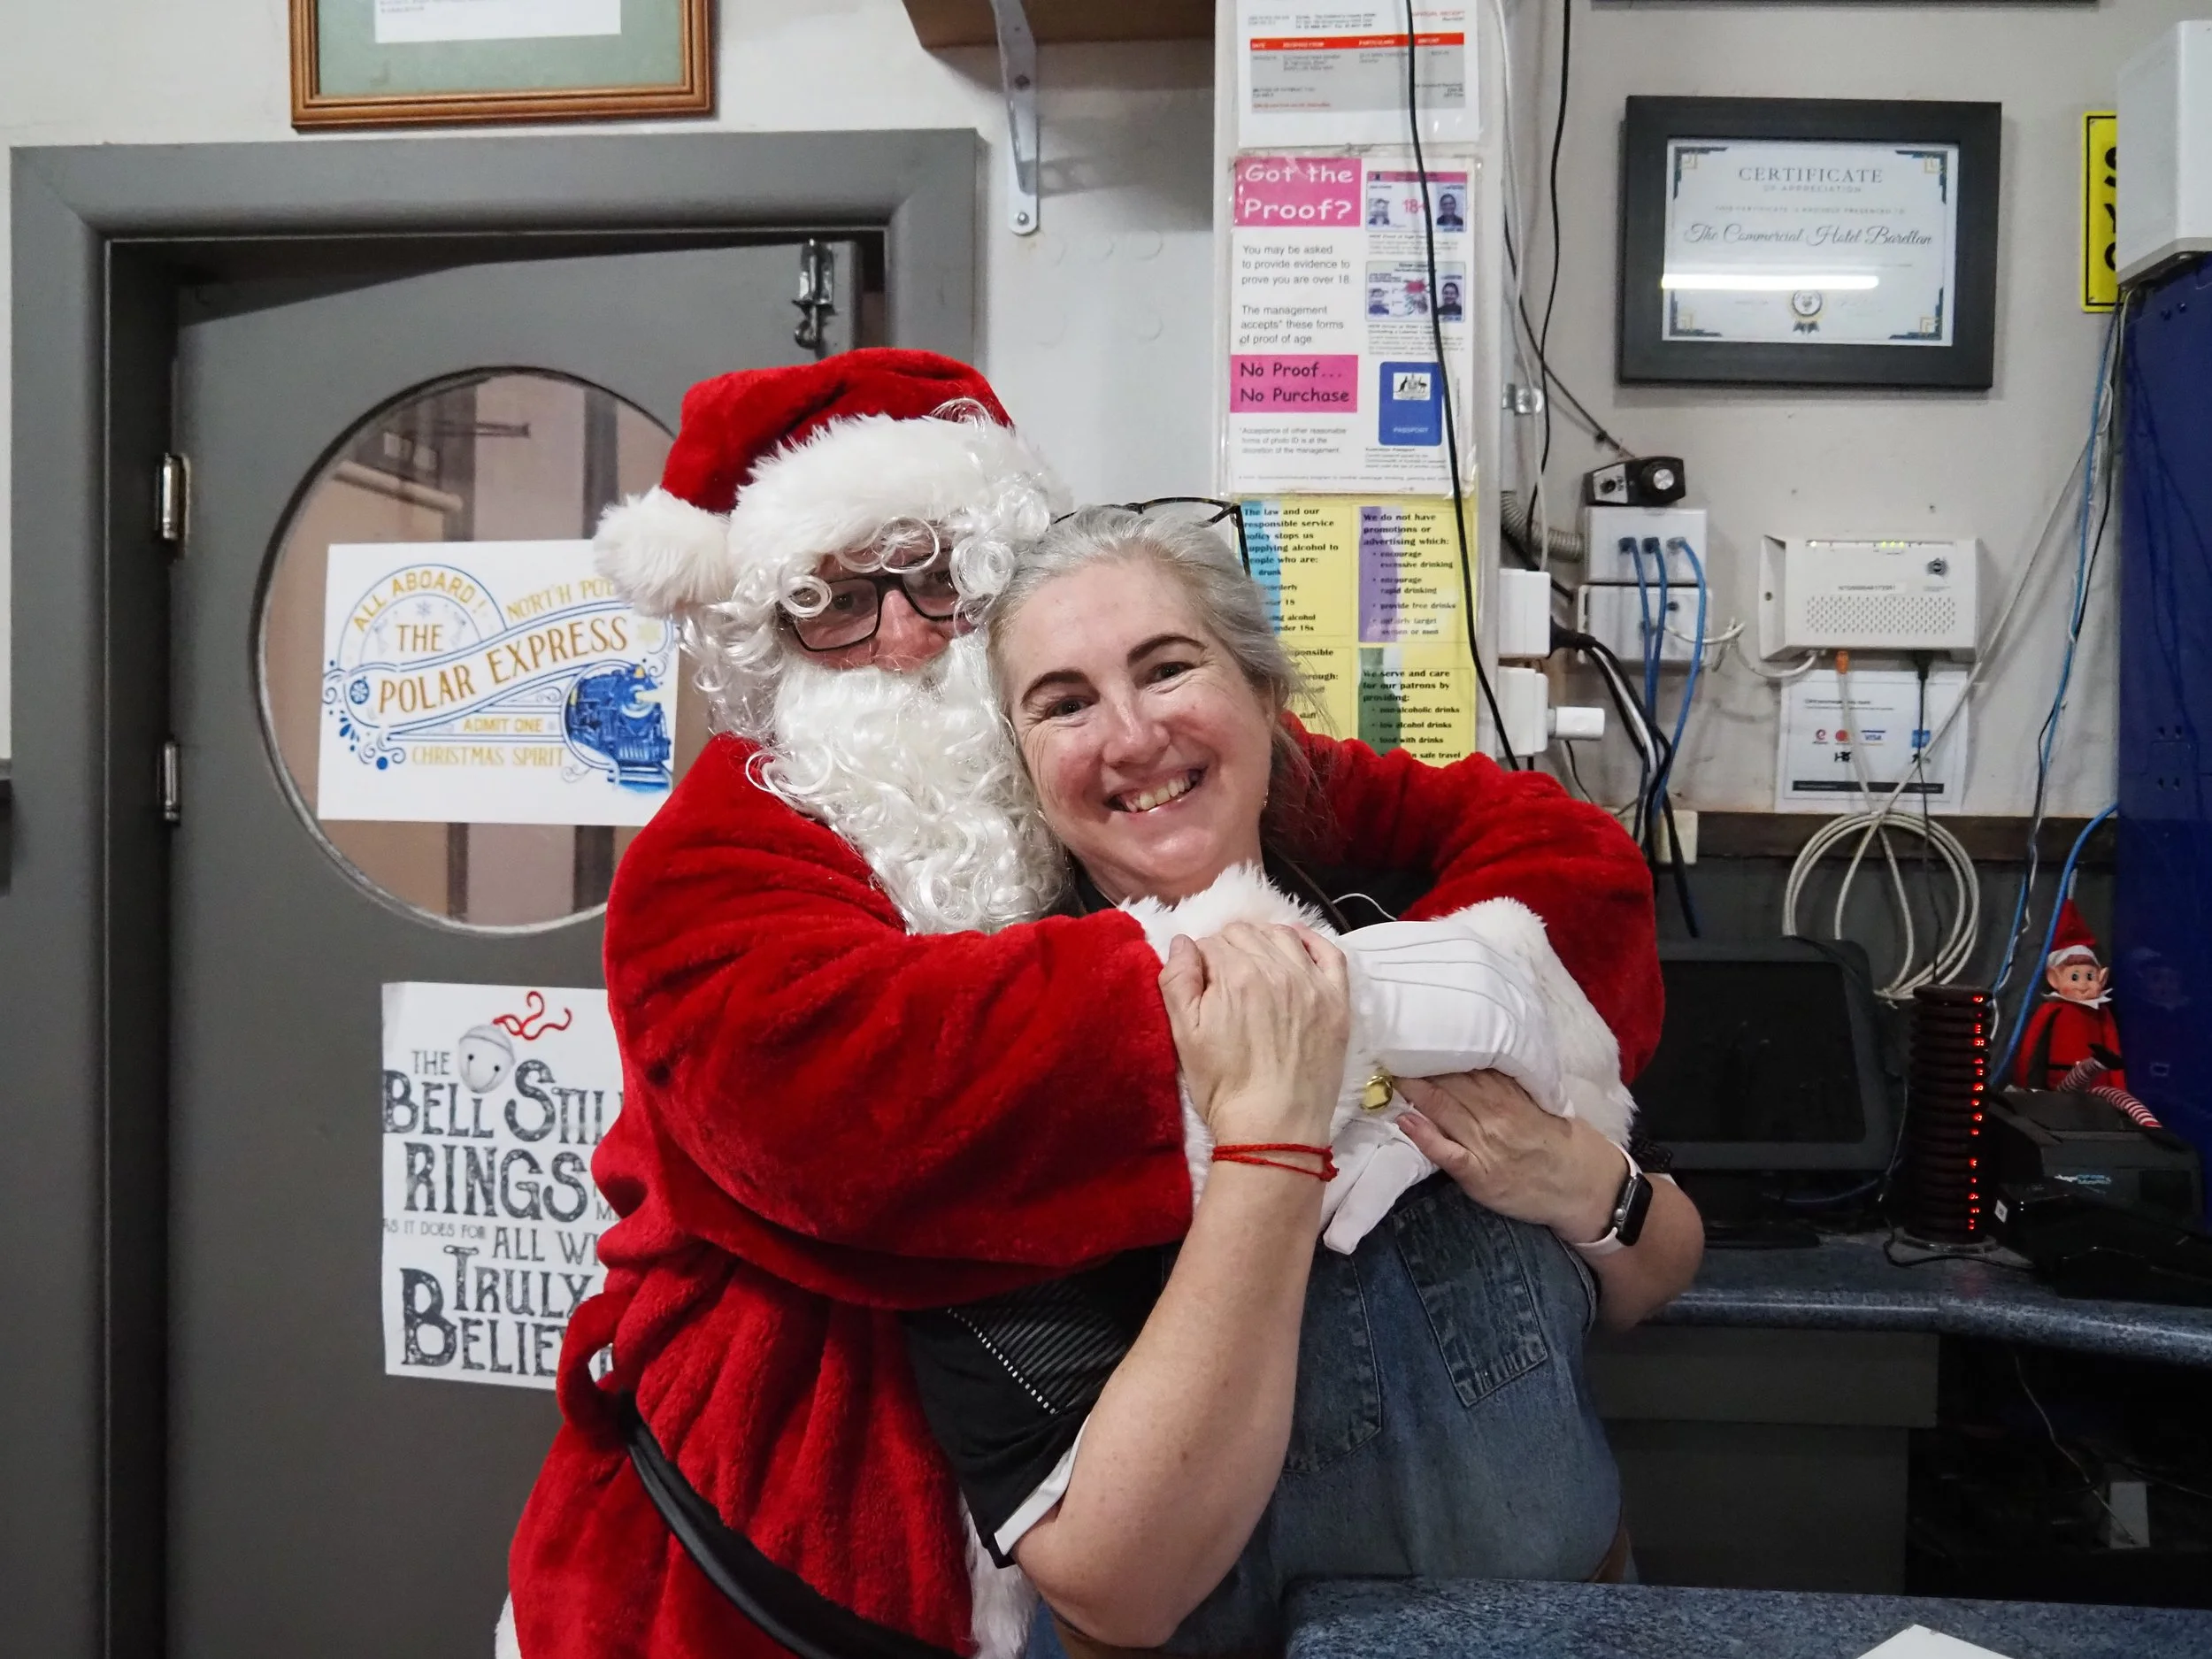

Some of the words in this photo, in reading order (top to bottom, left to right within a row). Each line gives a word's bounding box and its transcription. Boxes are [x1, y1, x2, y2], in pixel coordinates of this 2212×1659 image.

[1245, 164, 1294, 182] Got
[1307, 163, 1354, 183] the
[1739, 167, 1883, 183] CERTIFICATE
[1244, 198, 1352, 220] Proof?
[1684, 223, 1718, 243] The
[1724, 223, 1804, 243] Commercial
[1806, 225, 1862, 246] Hotel
[1243, 245, 1260, 255] You
[1264, 246, 1285, 256] may
[1288, 245, 1300, 254] be
[1303, 245, 1333, 254] asked
[1242, 260, 1251, 269] to
[1255, 260, 1290, 270] provide
[1294, 260, 1338, 269] evidence
[1340, 260, 1350, 269] to
[1241, 276, 1269, 286] prove
[1272, 276, 1290, 286] you
[1242, 305, 1260, 315] The
[1263, 306, 1327, 317] management
[1286, 319, 1313, 329] these
[1317, 319, 1344, 329] forms
[1240, 334, 1249, 344] of
[1253, 334, 1278, 345] proof
[1281, 334, 1291, 344] of
[1240, 363, 1264, 377] No
[1240, 388, 1264, 403] No
[1273, 388, 1349, 403] Purchase
[1244, 519, 1298, 529] responsible
[353, 592, 387, 633] ALL
[506, 584, 572, 621] NORTH
[396, 624, 443, 653] THE
[378, 664, 478, 715] POLAR
[485, 616, 628, 686] EXPRESS
[463, 718, 511, 733] ADMIT
[514, 718, 543, 733] ONE
[411, 746, 504, 766] CHRISTMAS
[512, 746, 565, 767] SPIRIT
[411, 1049, 450, 1076] THE
[383, 1070, 494, 1140] BELL
[403, 1141, 588, 1223] RINGS
[383, 1218, 397, 1233] AS
[404, 1219, 414, 1234] IT
[420, 1221, 455, 1237] DOES
[461, 1225, 486, 1240] FOR
[492, 1226, 546, 1262] ALL
[443, 1245, 595, 1318] TRULY
